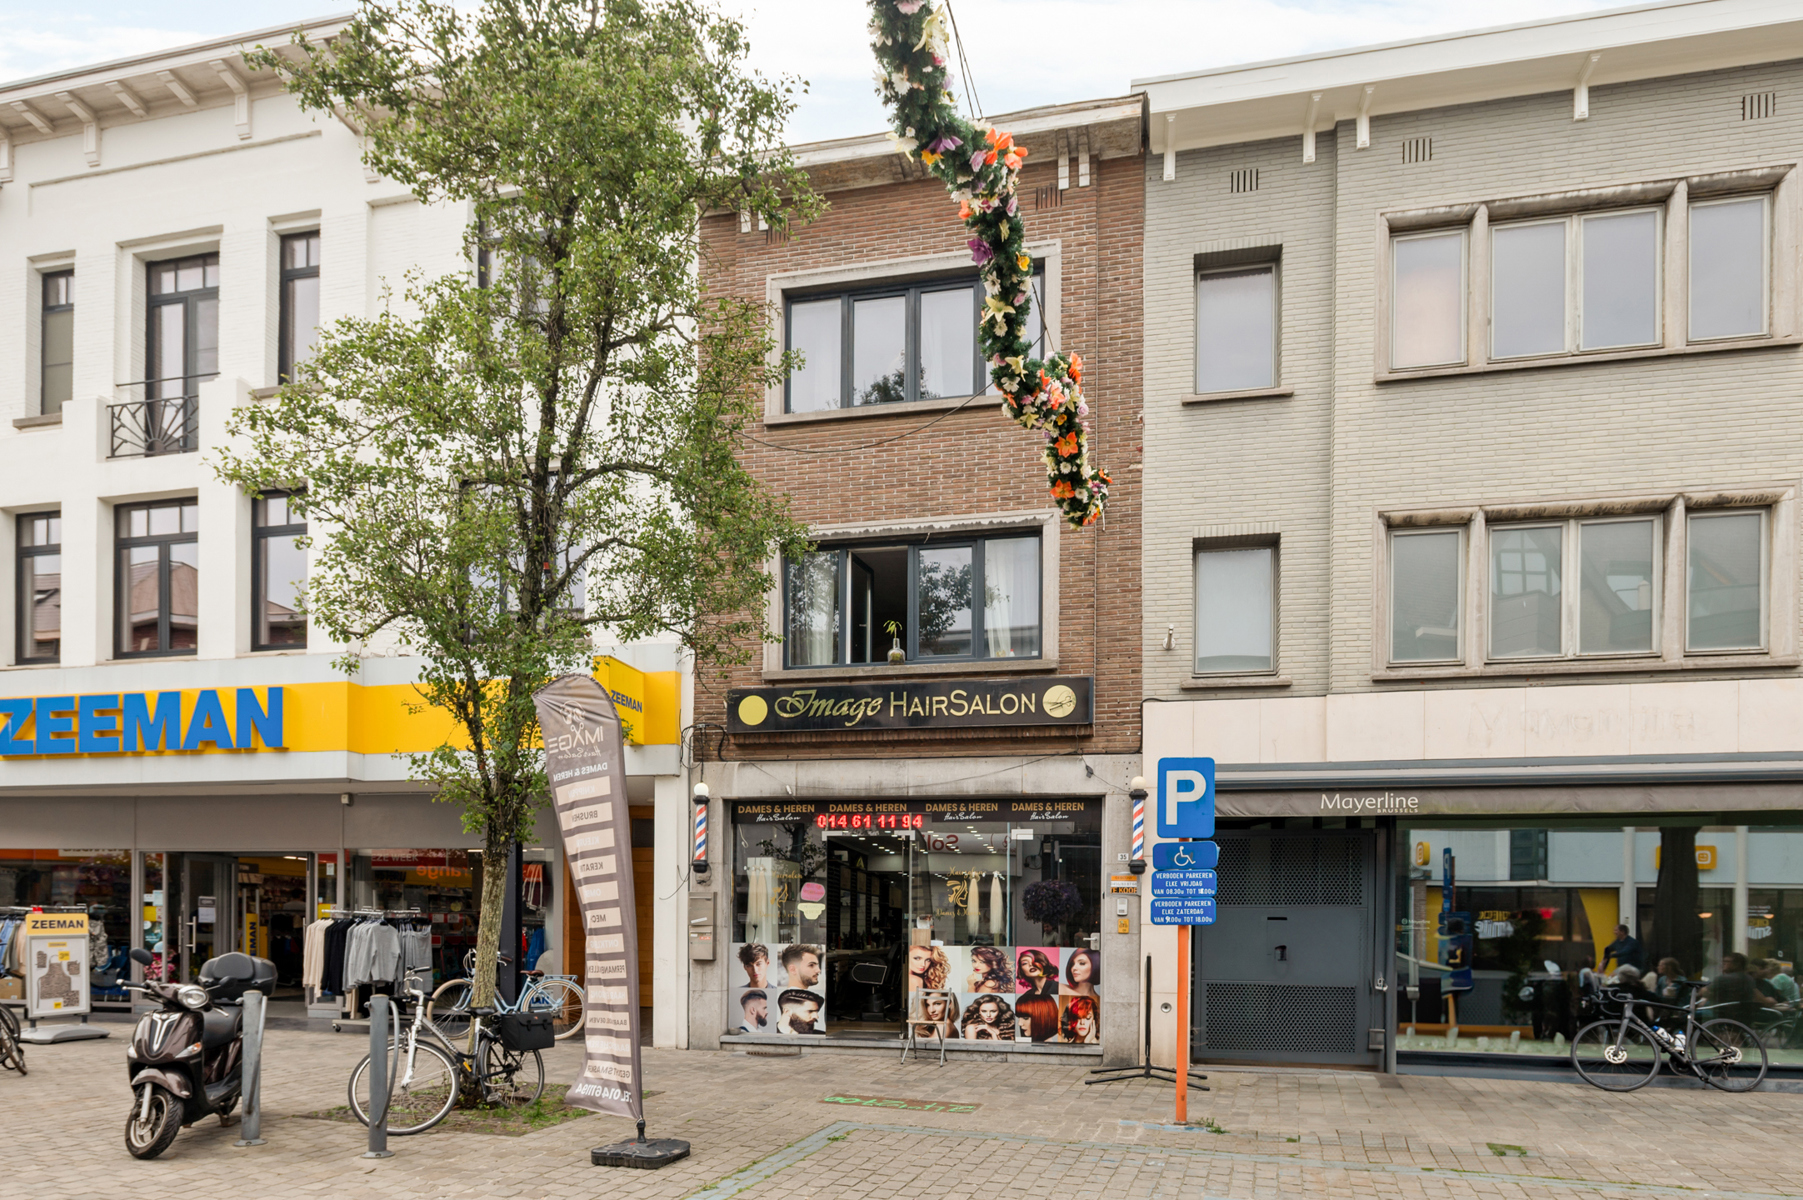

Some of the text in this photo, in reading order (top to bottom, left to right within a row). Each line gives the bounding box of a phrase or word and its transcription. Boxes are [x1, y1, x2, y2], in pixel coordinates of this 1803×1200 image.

[610, 689, 642, 714] ZEEMAN
[775, 690, 883, 726] Image
[0, 687, 284, 755] ZEEMAN
[1165, 770, 1207, 825] P
[1321, 792, 1419, 813] Mayerline
[738, 804, 815, 814] DAMES & HEREN
[829, 803, 907, 812] DAMES & HEREN
[926, 803, 998, 812] DAMES & HEREN
[1012, 802, 1084, 811] DAMES & HEREN
[817, 814, 923, 828] 014 61 11 94
[392, 854, 419, 862] WEEK
[32, 919, 84, 929] ZEEMAN
